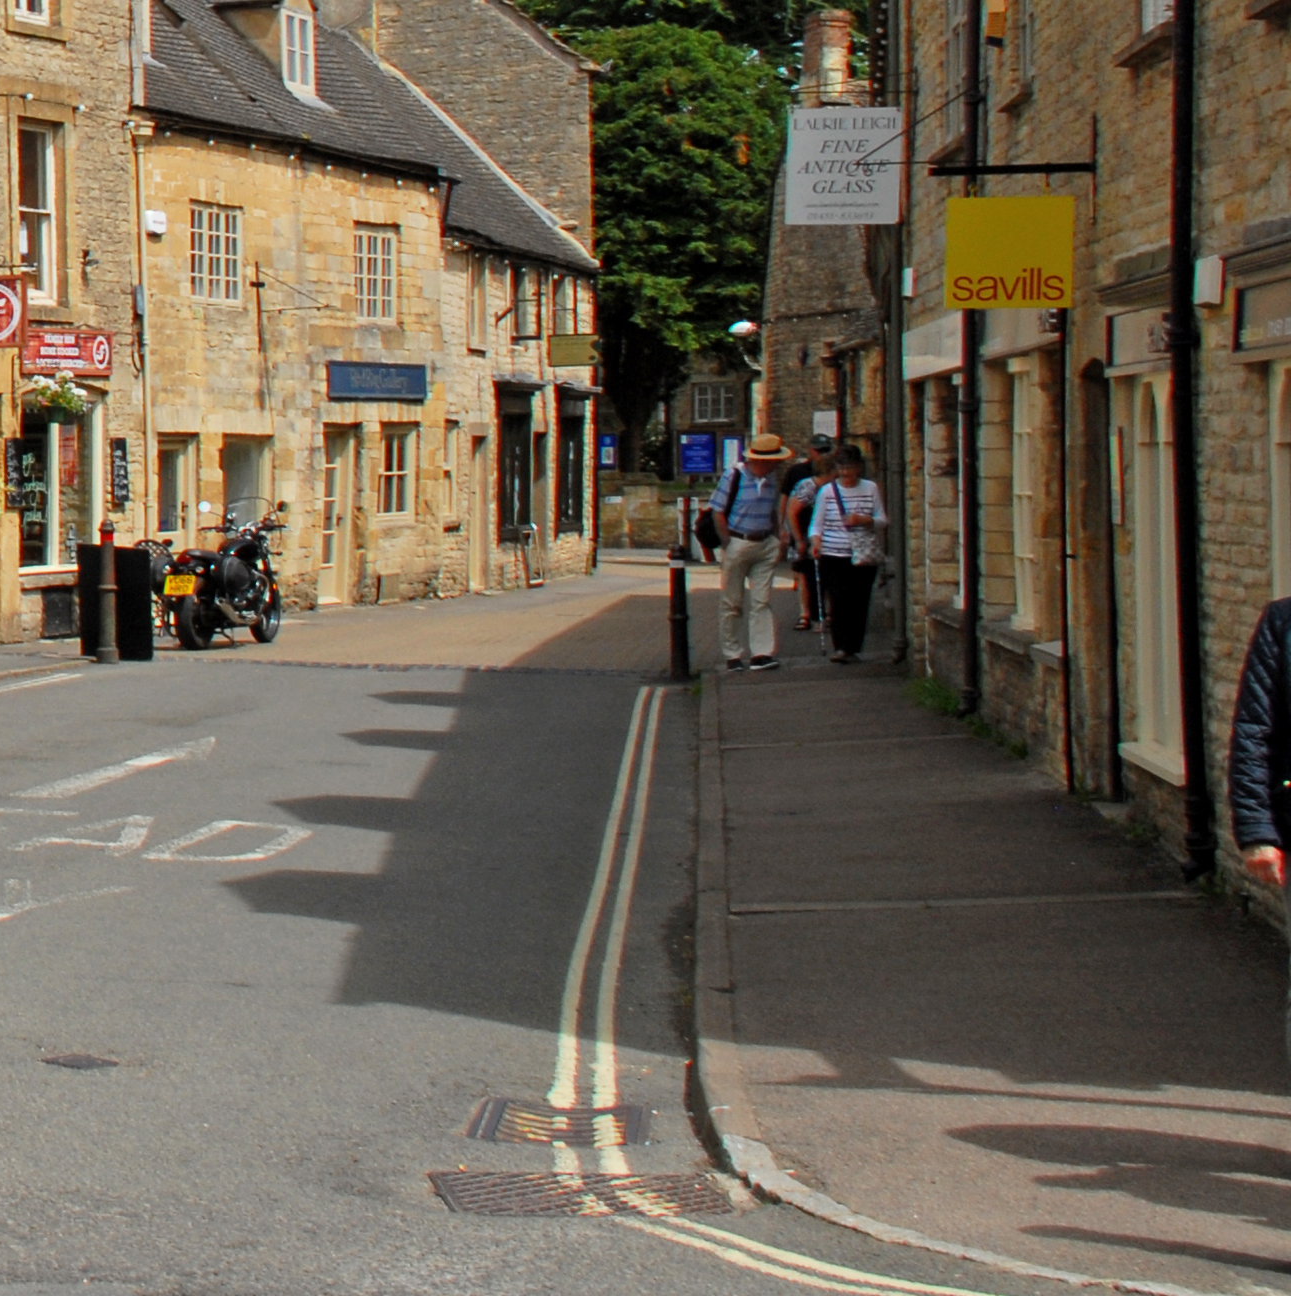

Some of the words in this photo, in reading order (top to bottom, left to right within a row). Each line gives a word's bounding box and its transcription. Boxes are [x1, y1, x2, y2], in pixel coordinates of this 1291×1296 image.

[793, 117, 847, 130] LAURIE
[820, 139, 869, 153] FINE
[797, 159, 891, 177] ANTIQUE
[812, 179, 875, 194] GLASS
[952, 267, 1065, 302] savills
